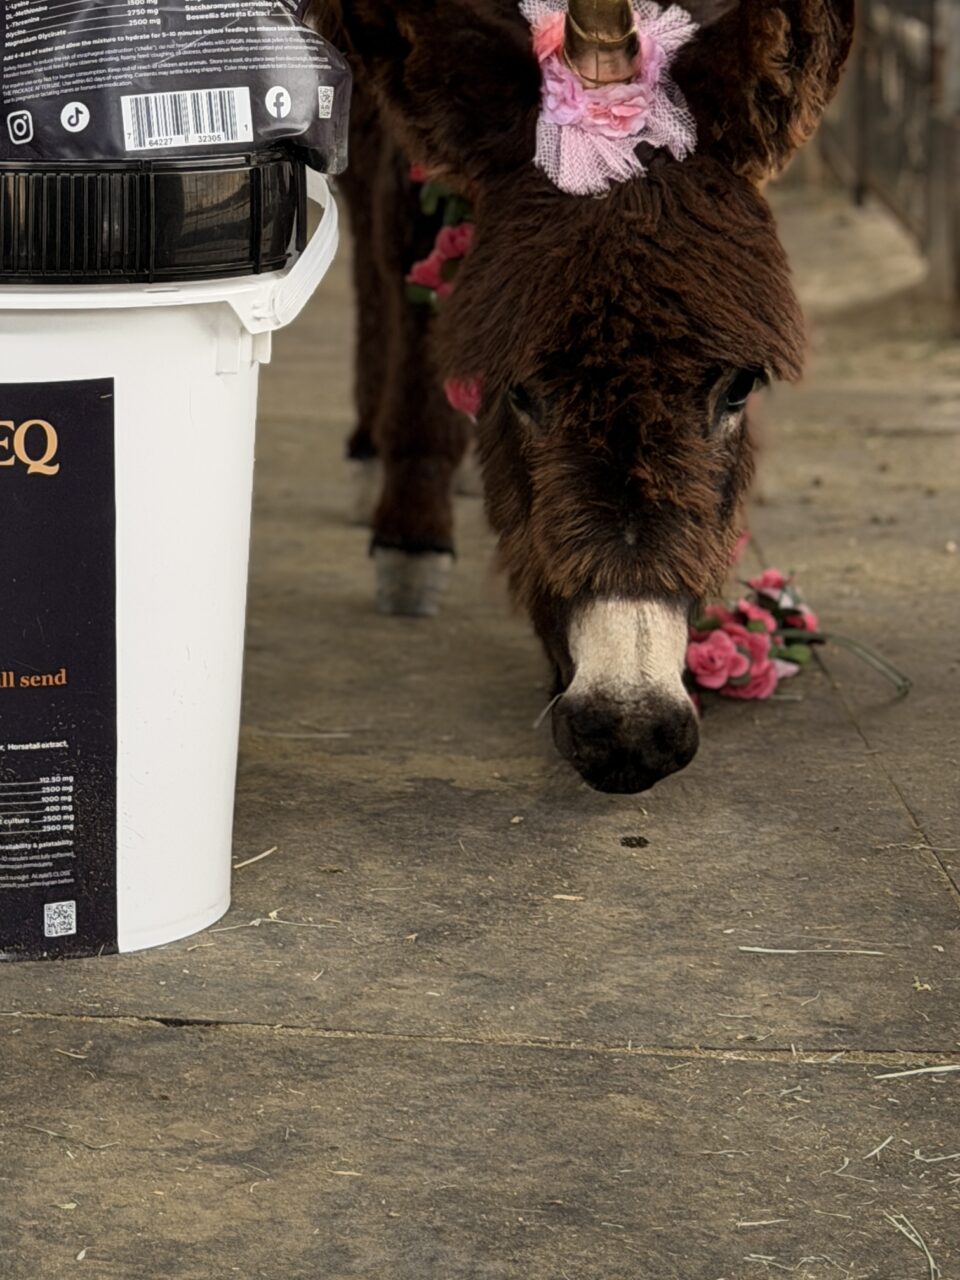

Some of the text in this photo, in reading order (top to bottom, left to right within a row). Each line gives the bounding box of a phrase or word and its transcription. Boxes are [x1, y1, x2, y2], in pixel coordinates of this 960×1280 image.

[148, 134, 222, 147] 64227 32305
[19, 668, 66, 687] send
